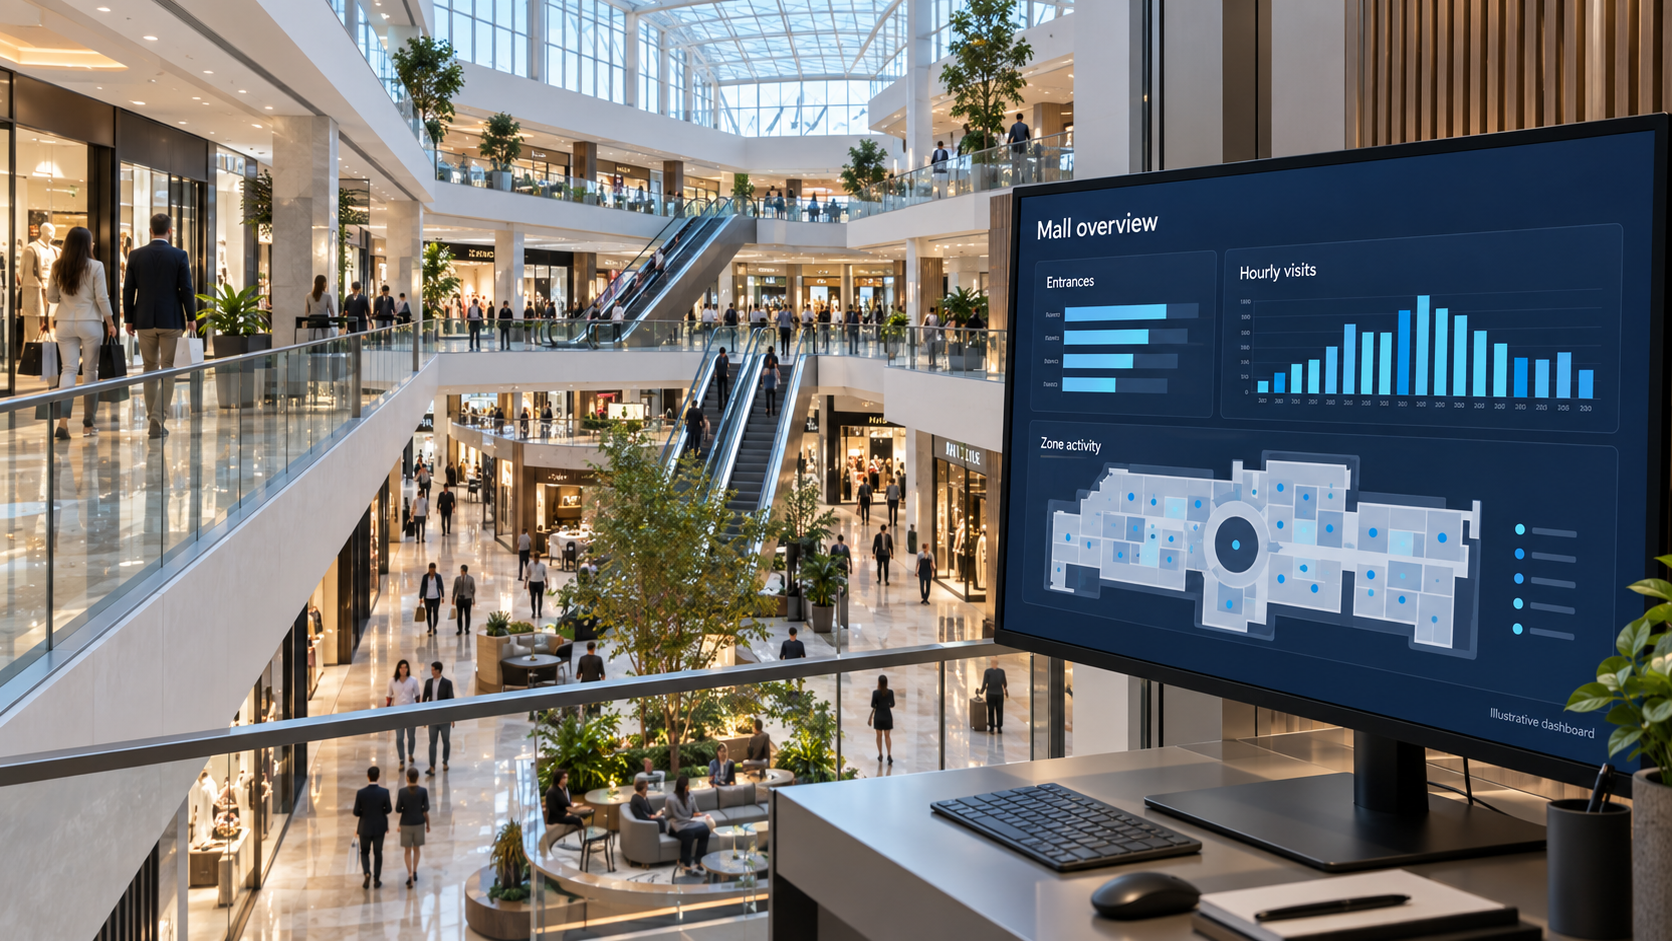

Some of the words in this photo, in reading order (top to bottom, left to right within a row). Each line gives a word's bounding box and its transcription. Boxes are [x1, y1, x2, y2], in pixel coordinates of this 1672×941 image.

[1037, 217, 1072, 240] Mall
[1076, 212, 1159, 237] overview
[1240, 264, 1281, 282] Hourly
[1283, 262, 1317, 278] visits
[1046, 276, 1095, 289] Entrances
[1040, 436, 1065, 450] Zone
[1066, 438, 1102, 456] activity
[1490, 707, 1540, 727] Illustrative
[1541, 718, 1596, 739] dashboard
